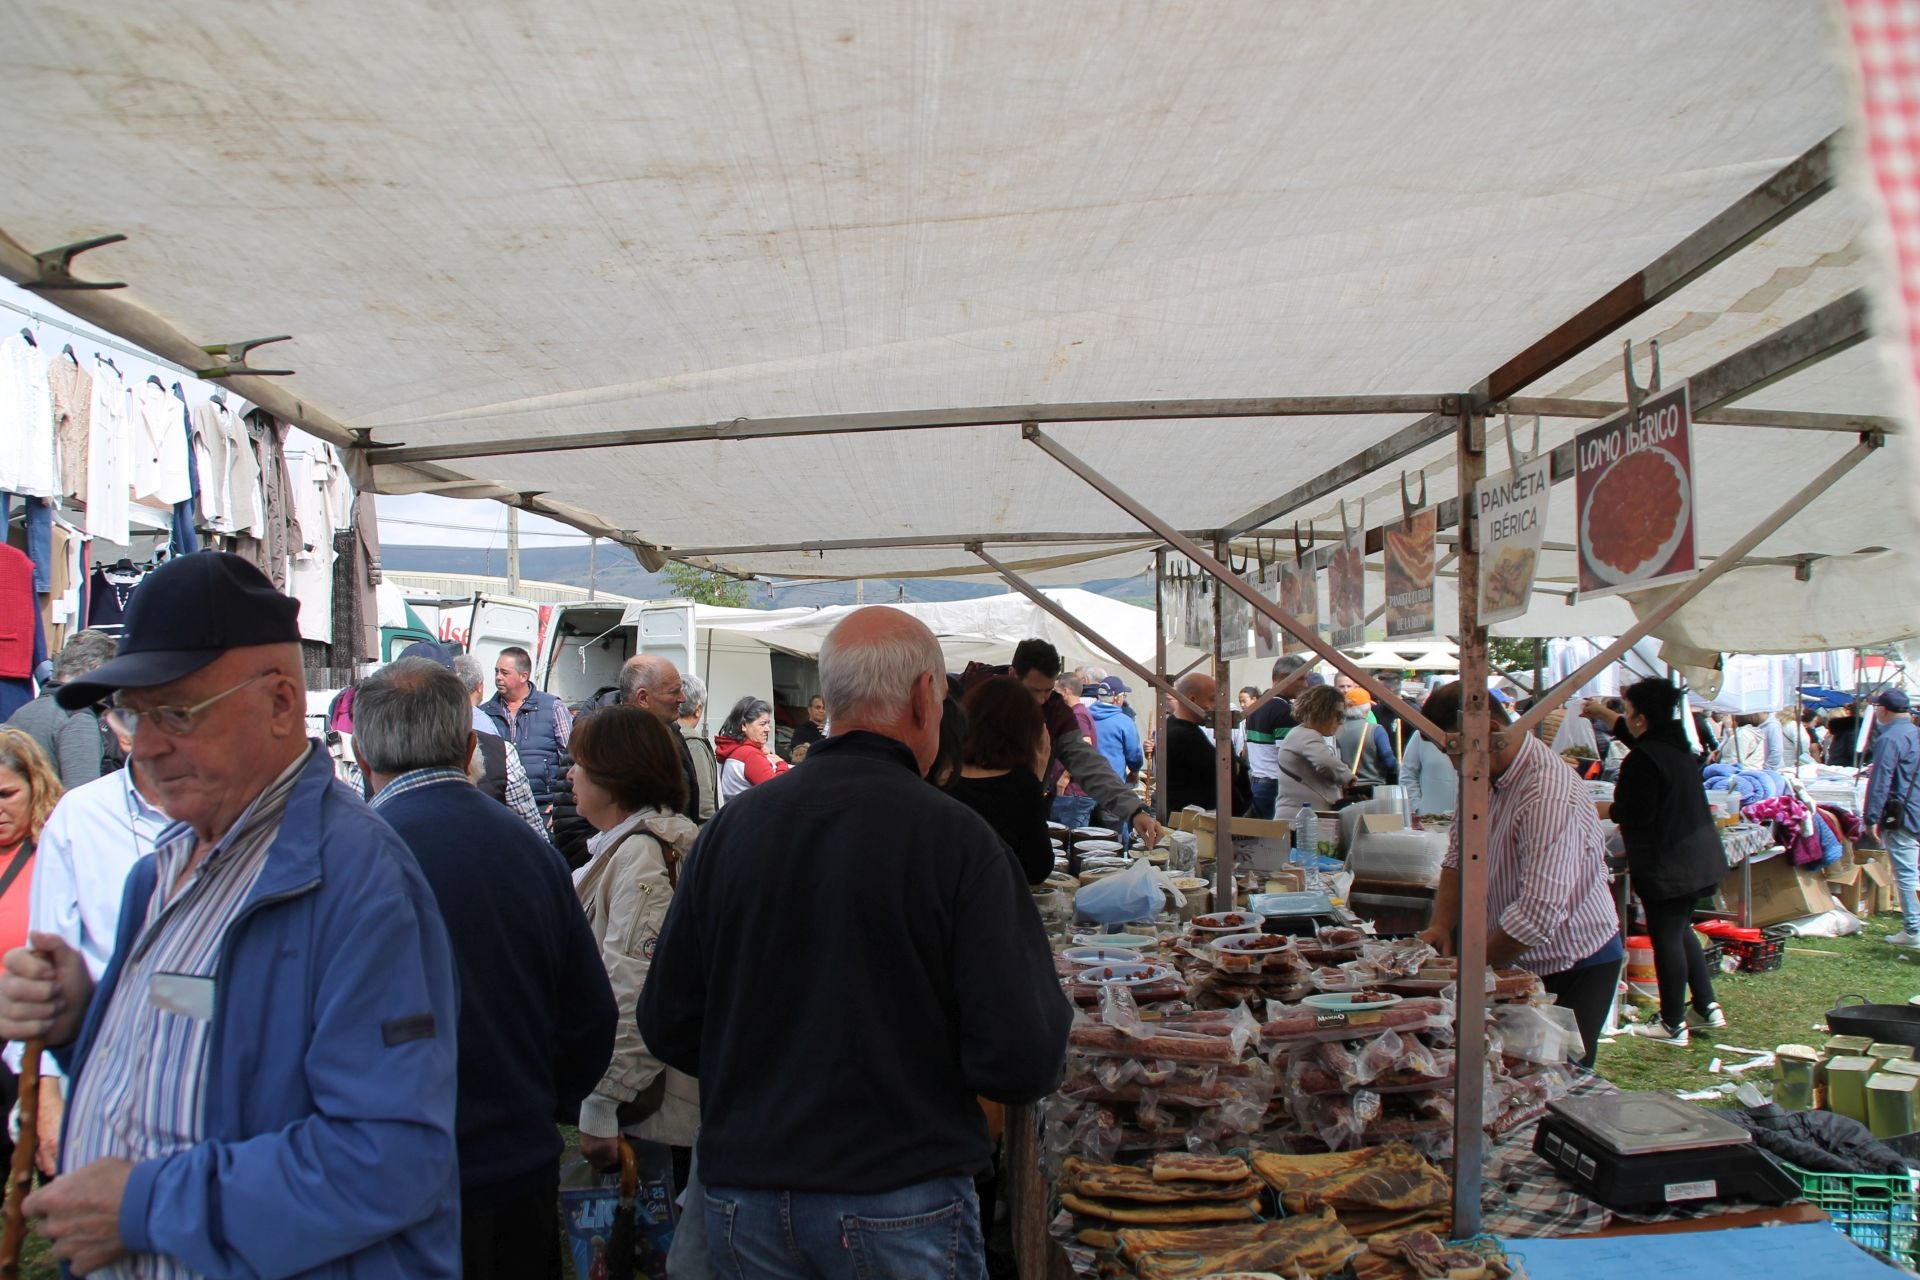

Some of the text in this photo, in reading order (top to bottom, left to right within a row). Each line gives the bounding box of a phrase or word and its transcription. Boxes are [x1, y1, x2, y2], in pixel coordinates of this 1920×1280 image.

[1580, 403, 1679, 473] LOMO IBÉRICO
[1480, 470, 1546, 514] PANCETA
[1489, 506, 1538, 543] IBÉRICA
